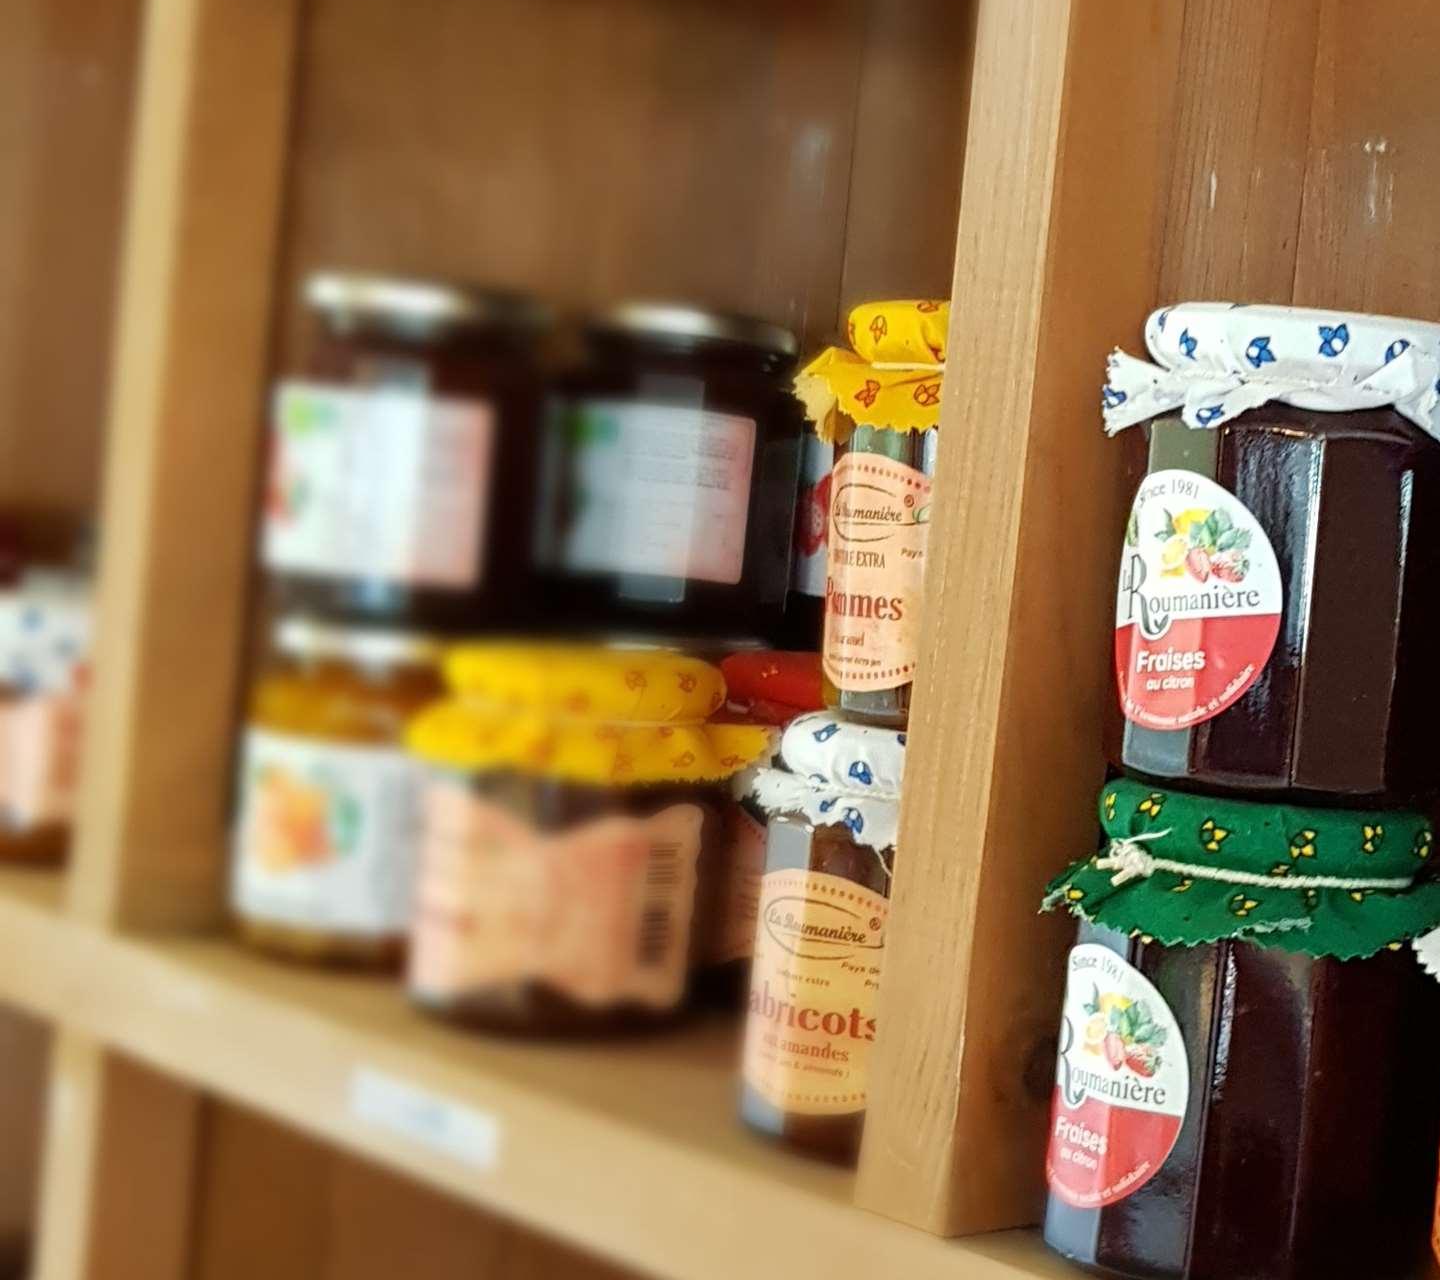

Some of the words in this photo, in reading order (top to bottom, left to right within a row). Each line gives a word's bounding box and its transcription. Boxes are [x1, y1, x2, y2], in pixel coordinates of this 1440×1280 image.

[1171, 479, 1199, 499] 1981
[856, 551, 886, 569] EXTRA
[1127, 553, 1261, 635] Roumanière
[1135, 649, 1206, 673] Fraises
[781, 1037, 850, 1063] amandes
[1054, 1115, 1109, 1156] Fraises
